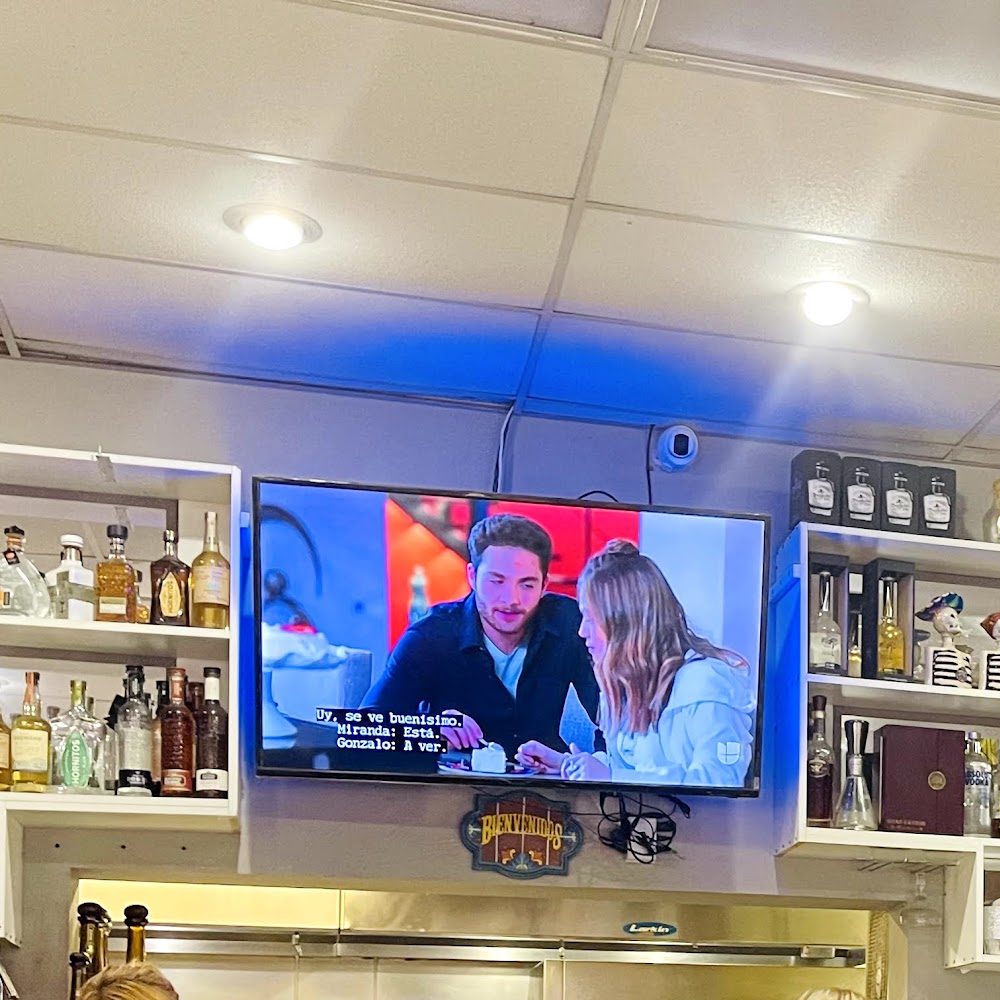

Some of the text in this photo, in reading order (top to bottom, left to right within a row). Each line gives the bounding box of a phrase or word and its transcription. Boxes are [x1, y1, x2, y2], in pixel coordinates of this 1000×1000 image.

[316, 709, 338, 722] Uy,
[345, 713, 362, 722] se
[367, 713, 384, 723] ve
[337, 724, 440, 739] Miranda: Está.
[336, 737, 447, 752] Gonzalo: A ver.
[71, 738, 80, 784] HORNITOS
[965, 778, 989, 787] VODKA
[481, 813, 563, 850] BIENVENIDOS
[629, 923, 670, 934] Larkin
